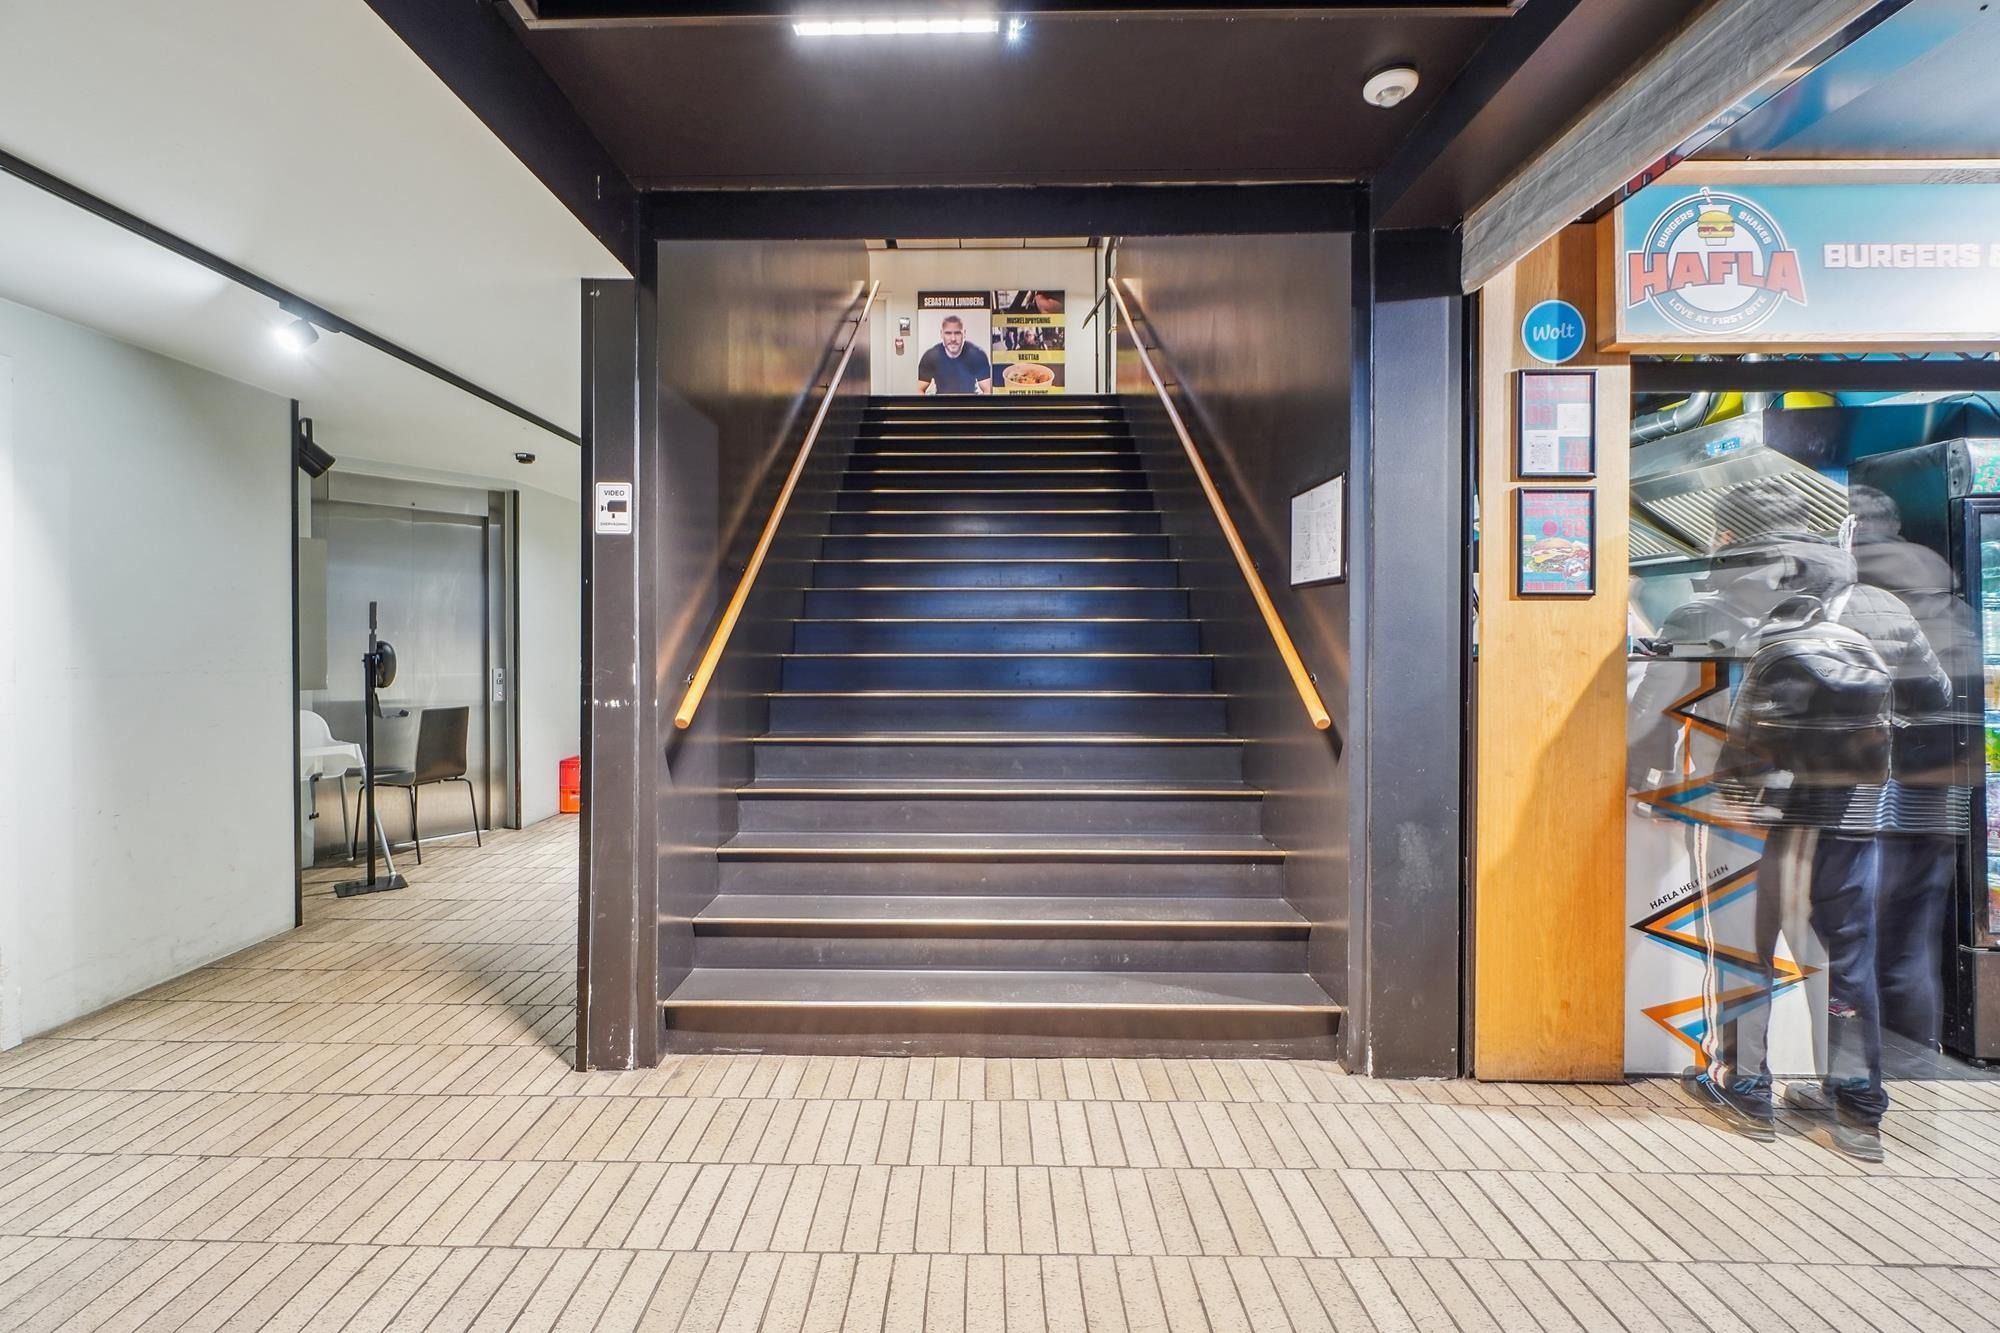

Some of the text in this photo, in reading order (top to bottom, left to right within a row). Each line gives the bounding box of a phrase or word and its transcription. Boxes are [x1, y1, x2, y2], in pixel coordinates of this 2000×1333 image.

[1657, 209, 1695, 249] BURGERS
[1738, 211, 1773, 245] SHAKES
[1823, 243, 1982, 269] BURGERS
[1627, 251, 1807, 307] HAFLA
[924, 297, 955, 306] SEBASTIAN
[1667, 295, 1767, 325] LOVE AT FIRST BITE
[1532, 322, 1576, 342] Wolt
[603, 489, 625, 497] VIDEO
[1649, 890, 1680, 910] HAFLA
